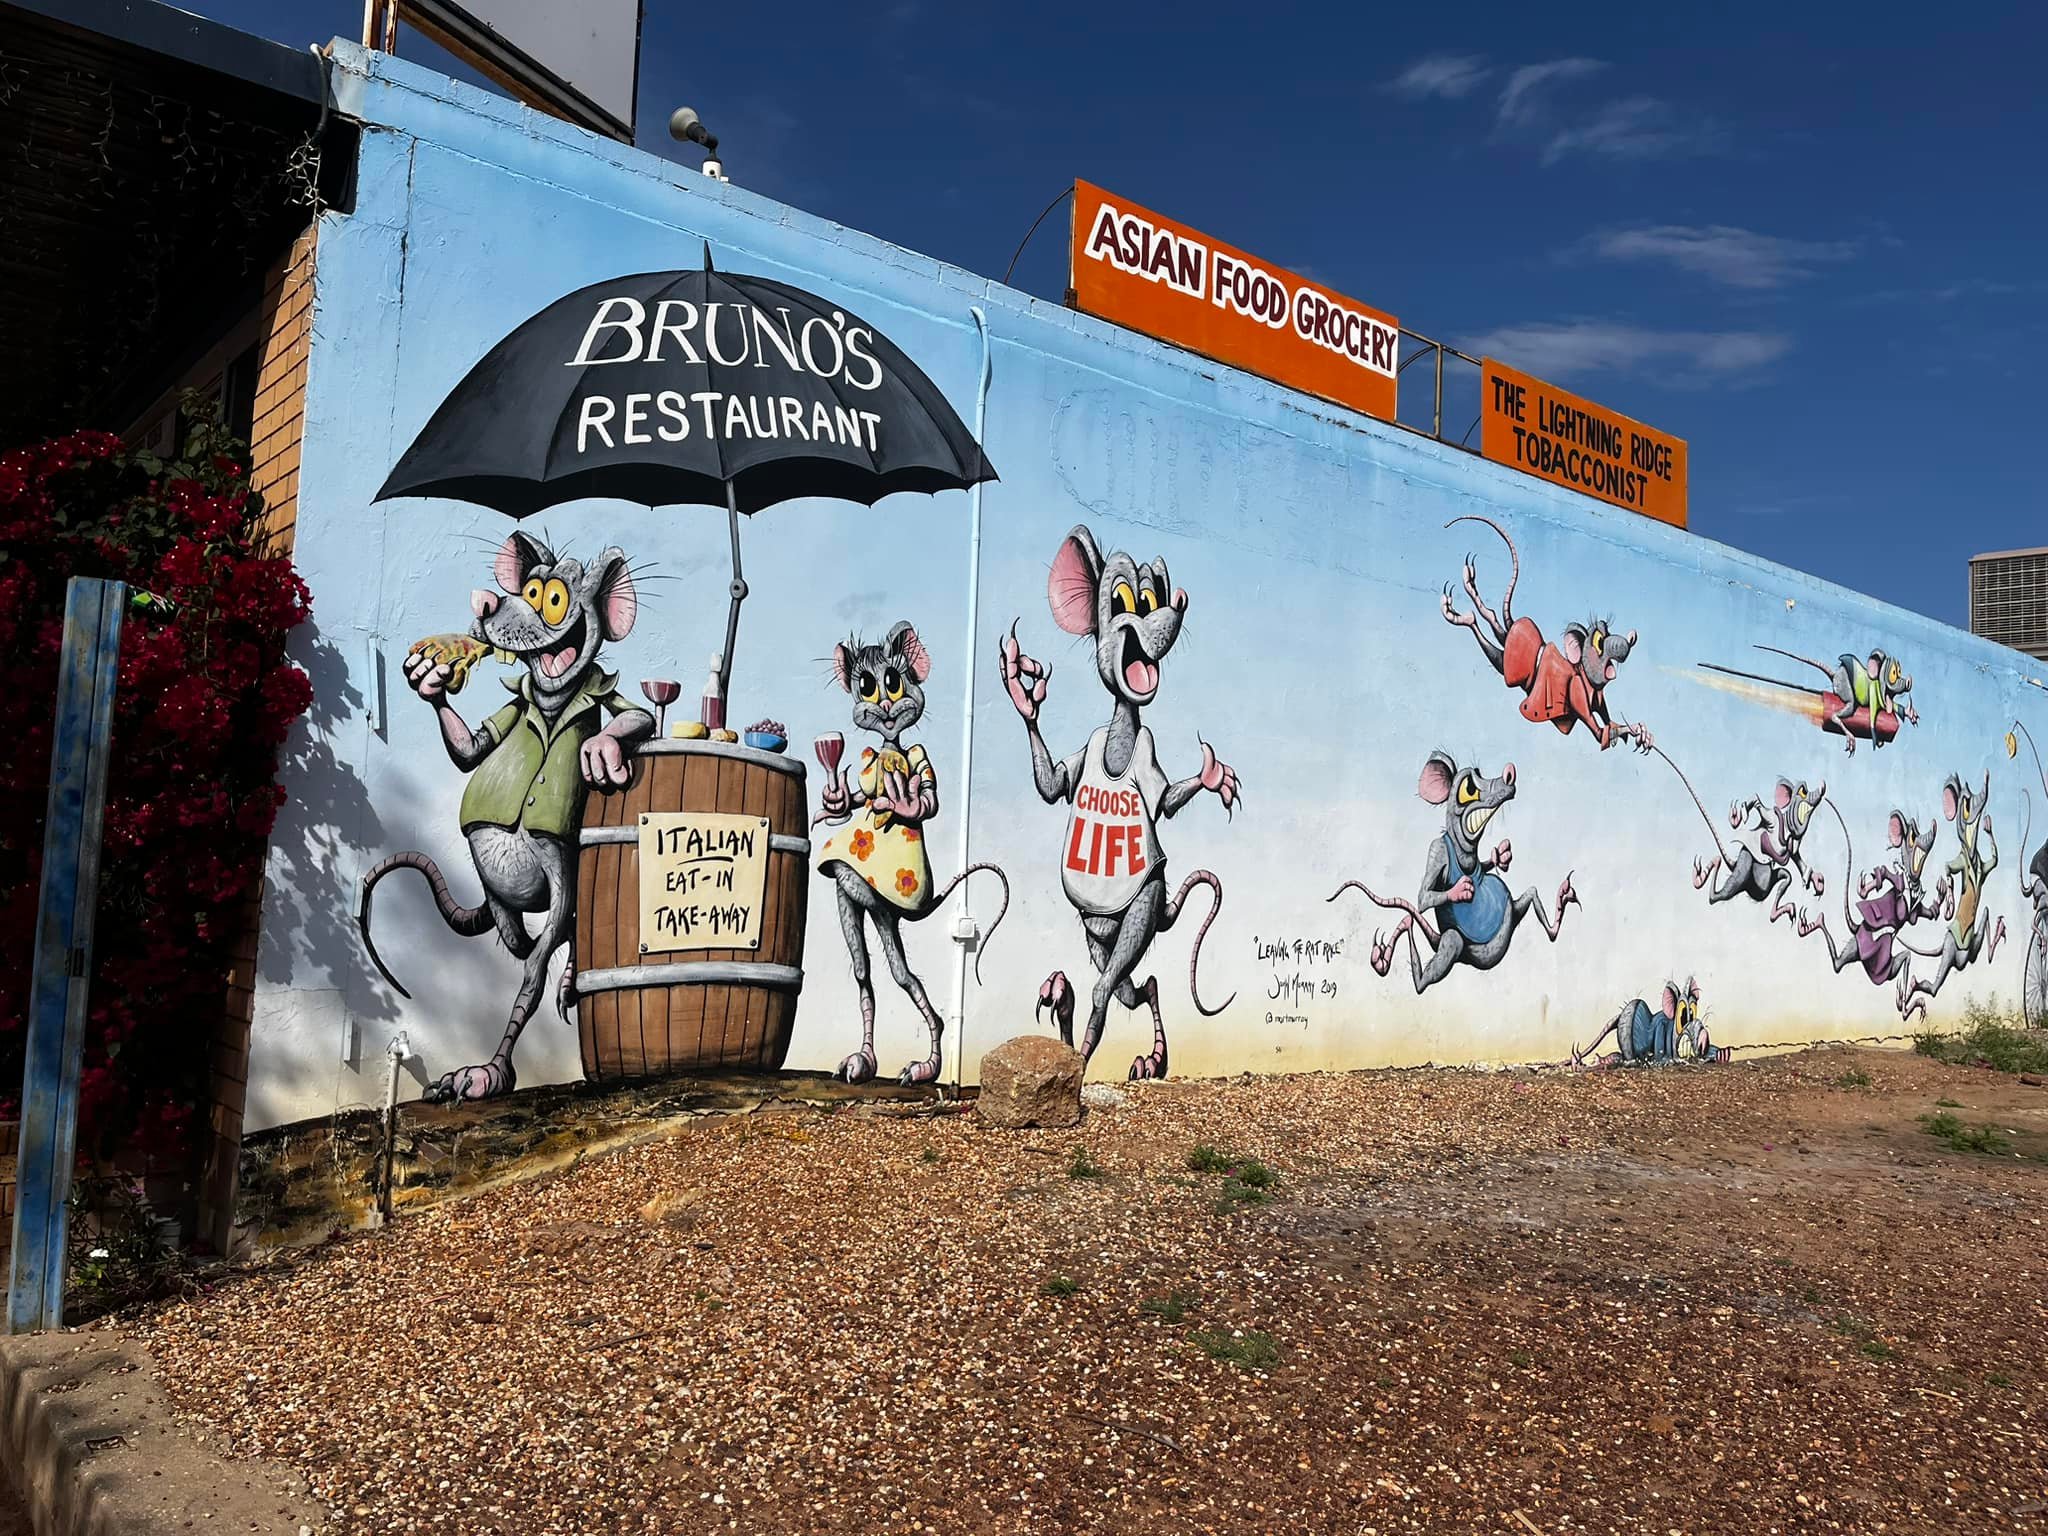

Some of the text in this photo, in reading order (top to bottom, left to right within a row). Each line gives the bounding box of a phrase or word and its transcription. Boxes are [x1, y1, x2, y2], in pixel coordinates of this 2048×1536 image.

[1091, 211, 1397, 372] ASIAN FOOD GROCERY
[564, 297, 884, 390] BRUNO'S
[577, 390, 882, 454] RESTAURANT
[1491, 375, 1672, 482] THE LIGHTNING RIDGE
[1513, 425, 1648, 507] TOBACCONIST
[1077, 785, 1141, 817] CHOOSE
[657, 826, 754, 858] ITALIAN
[1066, 816, 1146, 877] LIFE
[666, 867, 734, 895] EAT-IN
[654, 902, 750, 937] TAKE-AWAY
